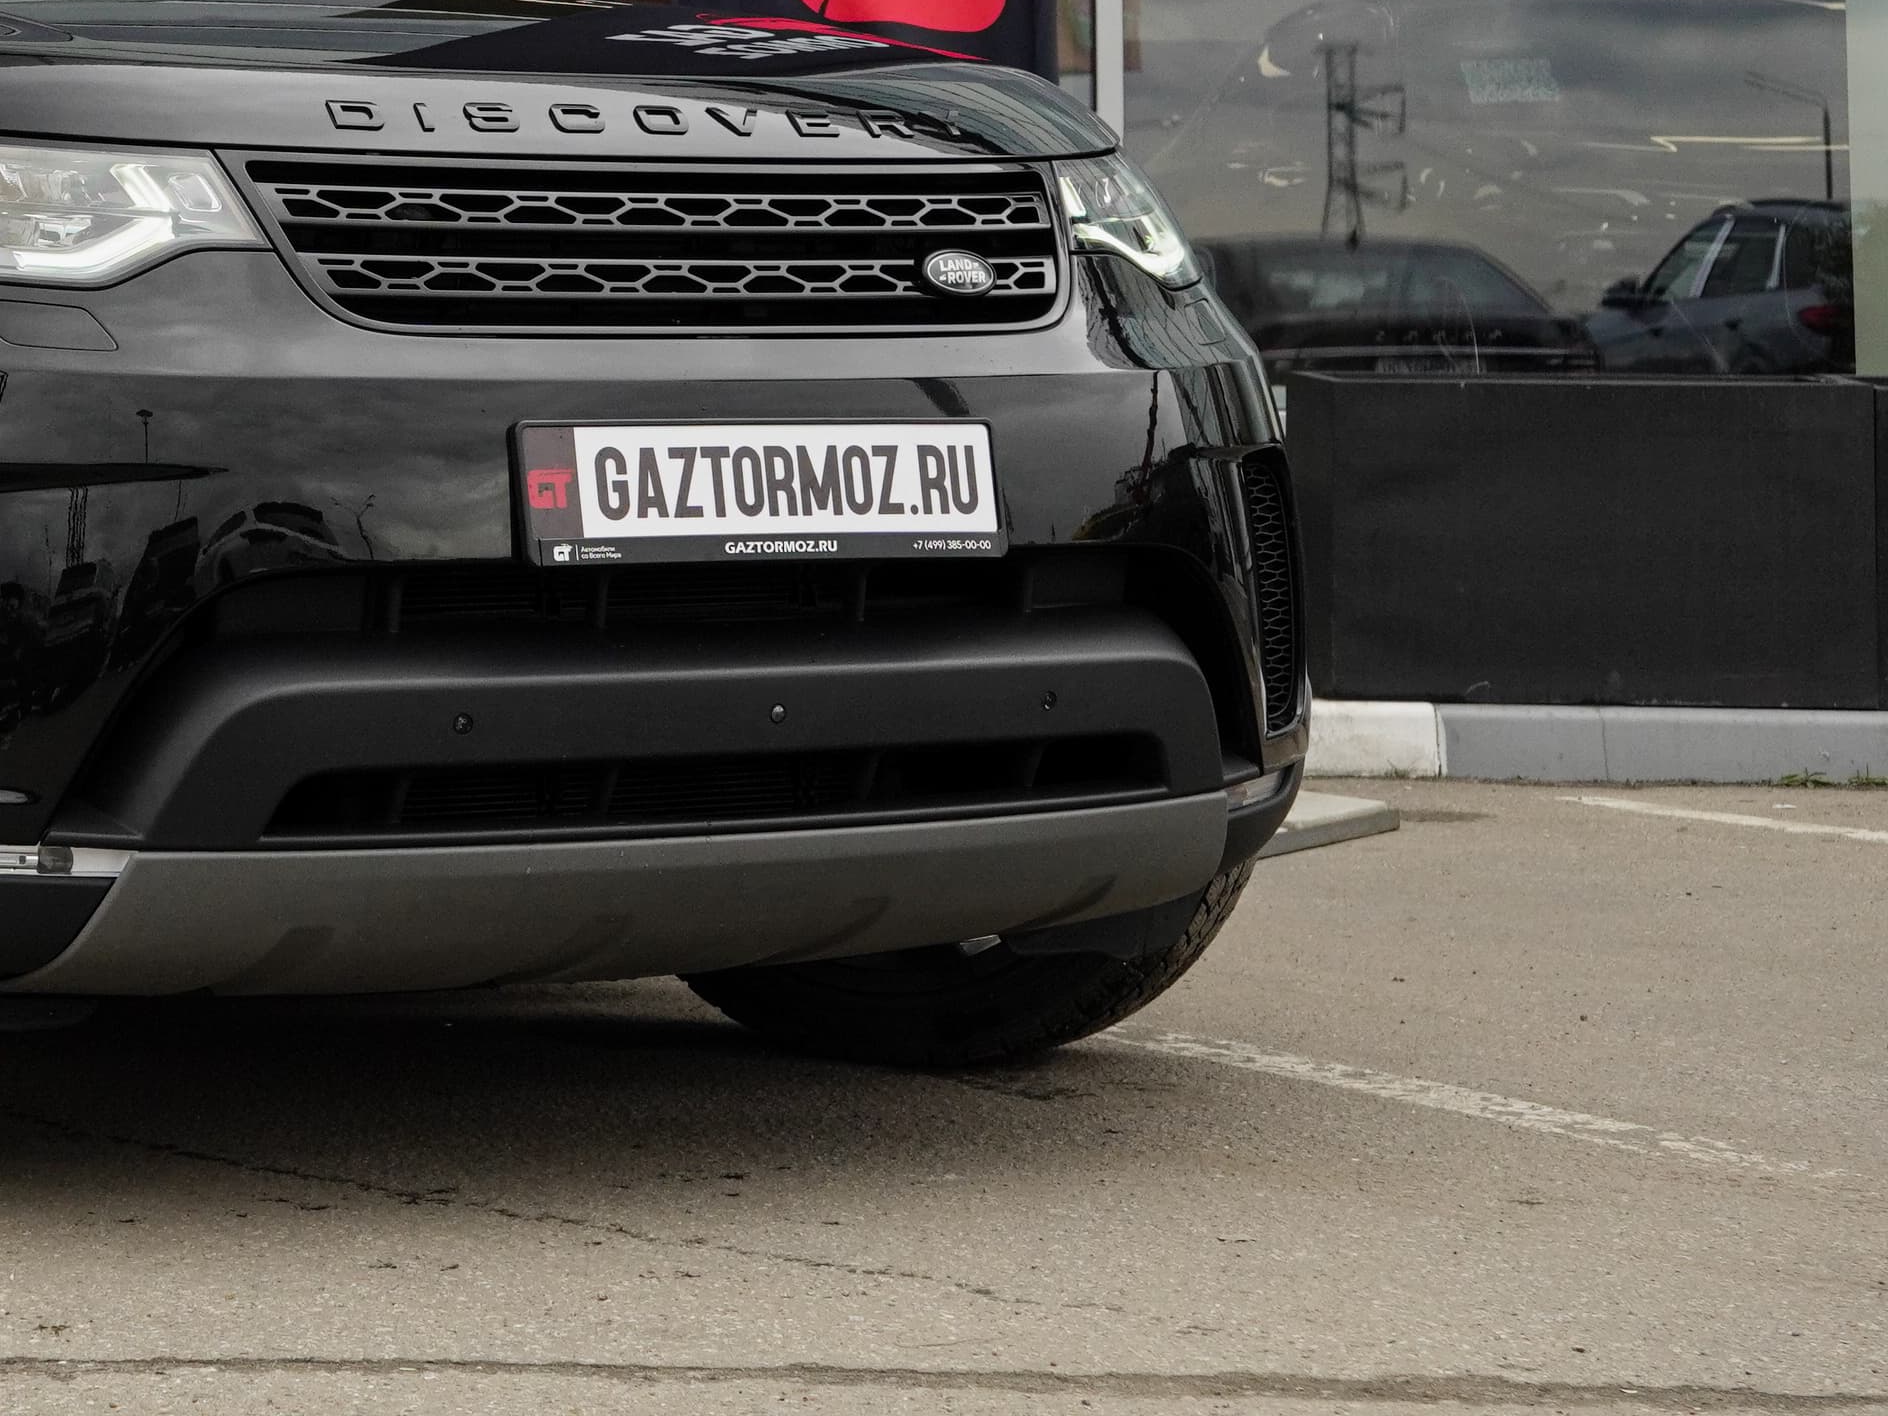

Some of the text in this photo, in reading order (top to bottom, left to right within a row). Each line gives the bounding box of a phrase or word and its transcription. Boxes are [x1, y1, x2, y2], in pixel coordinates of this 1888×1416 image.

[325, 99, 962, 137] DISCOVERY
[938, 258, 972, 272] LAND
[947, 270, 987, 284] ROVER
[593, 444, 980, 522] GAZTORMOZ.RU
[724, 539, 839, 555] GAZTORMOZ.RU
[946, 539, 992, 551] 385-00-00
